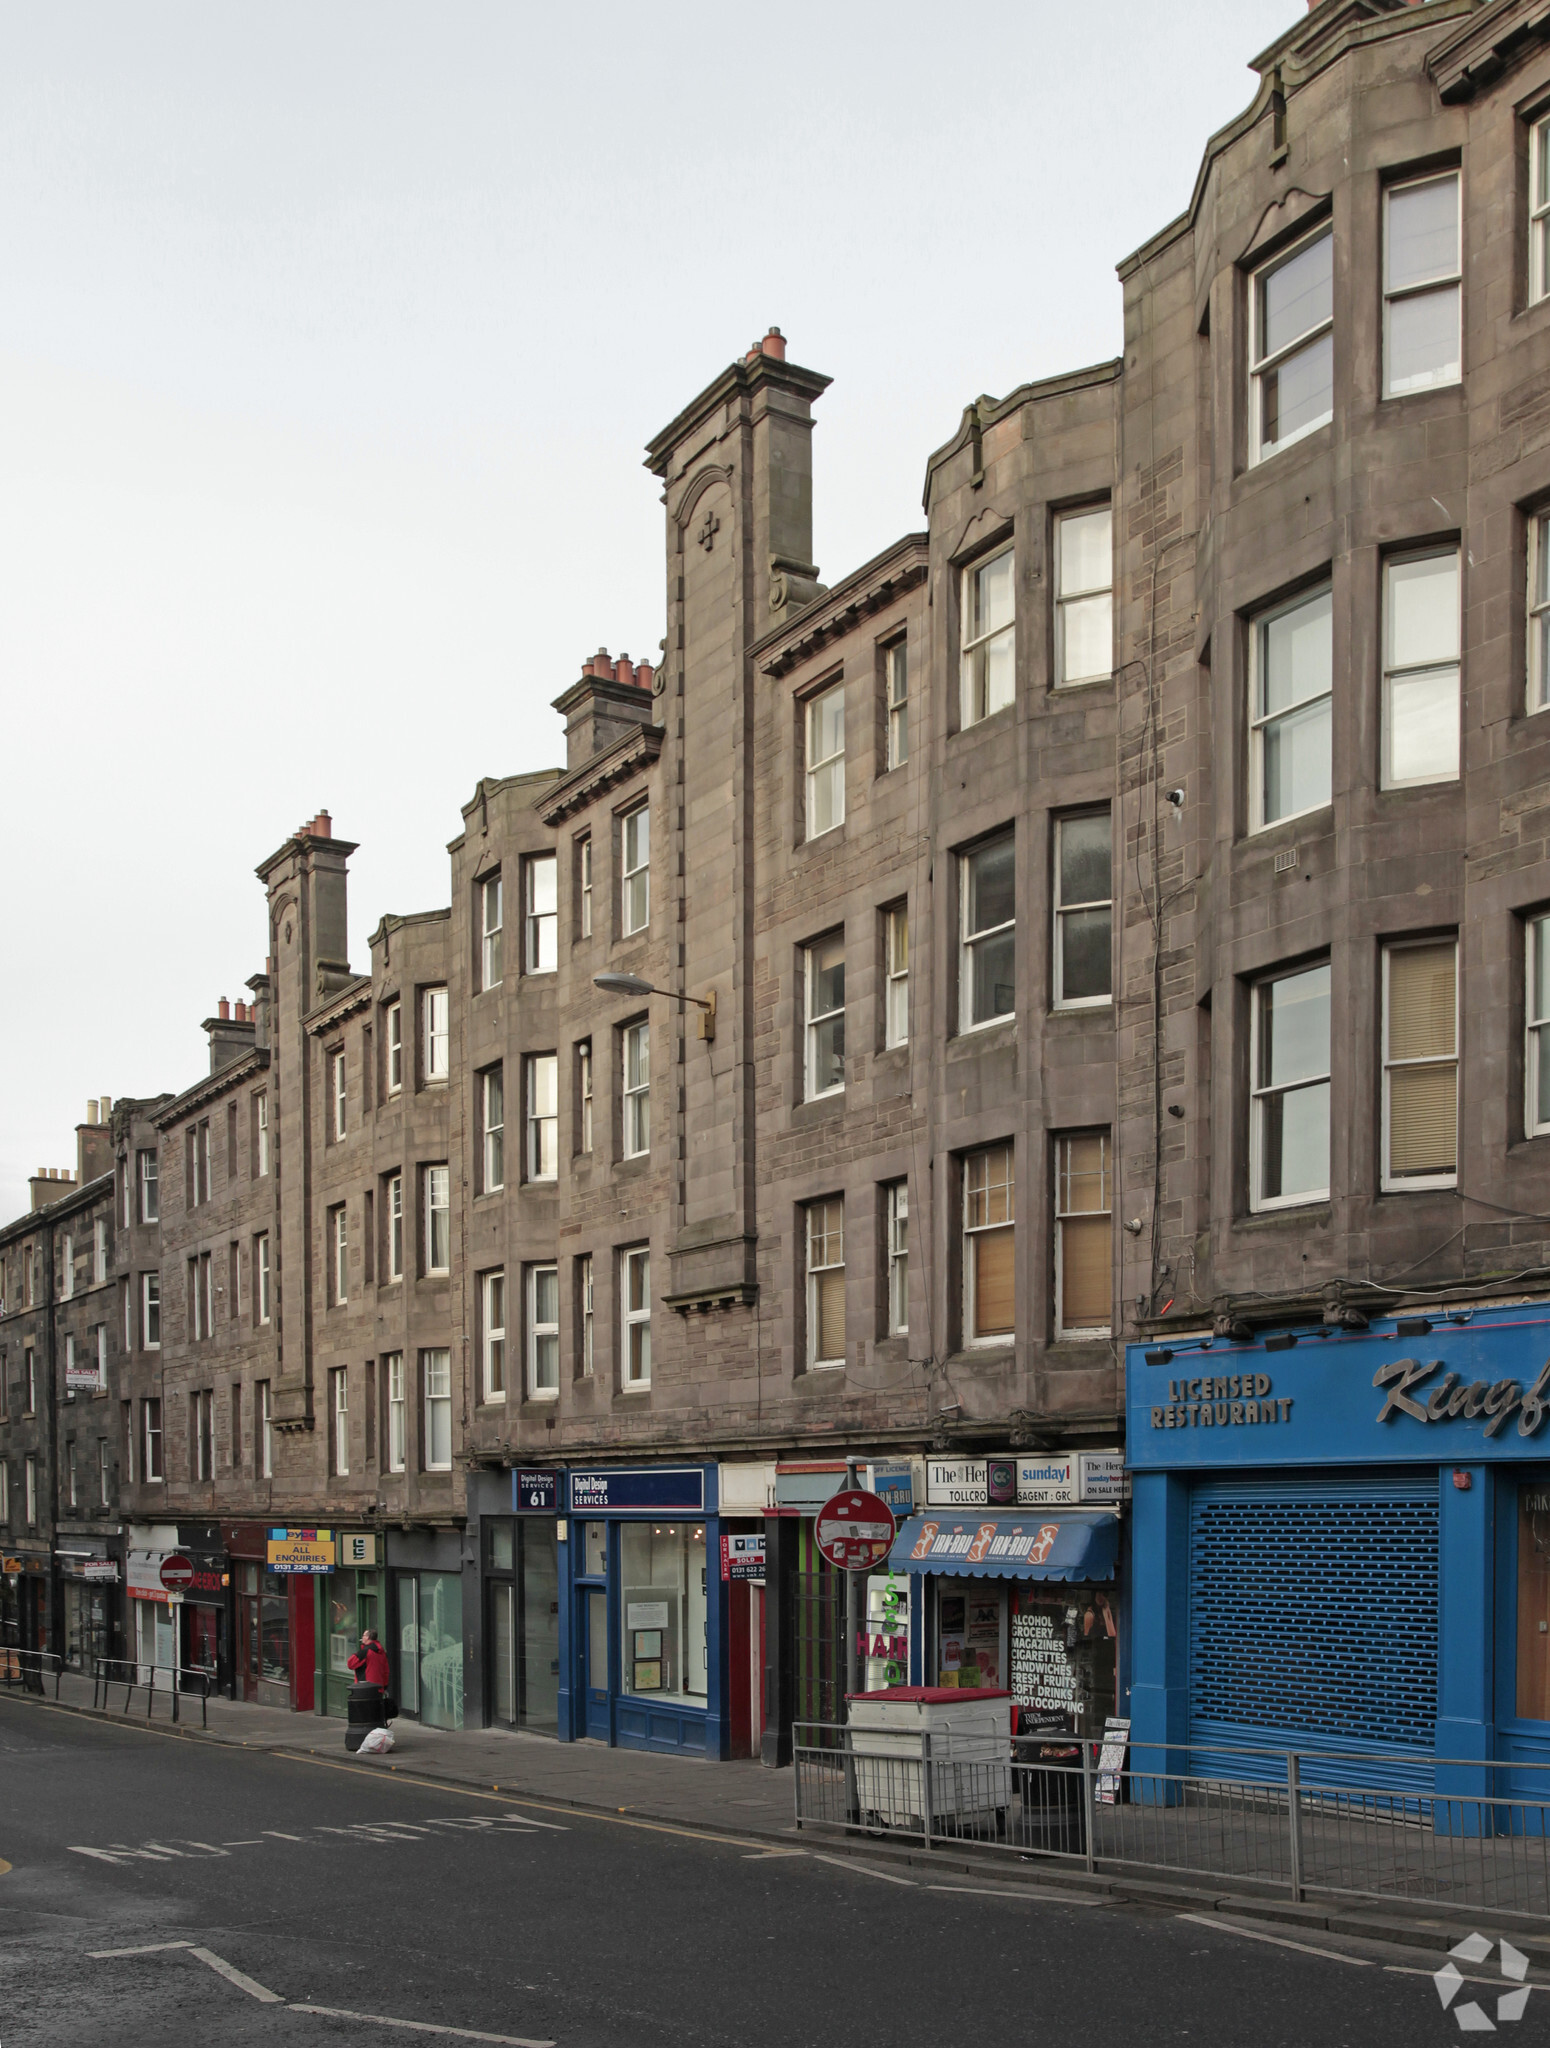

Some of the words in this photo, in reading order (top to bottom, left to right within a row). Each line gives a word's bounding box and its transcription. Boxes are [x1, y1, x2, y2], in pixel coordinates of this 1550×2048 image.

[1168, 1373, 1273, 1402] LICENSED
[1150, 1398, 1294, 1429] RESTAURANT
[1086, 1462, 1101, 1471] The
[521, 1474, 537, 1483] Digital
[537, 1474, 554, 1483] Design
[933, 1466, 957, 1483] The
[965, 1466, 987, 1483] Her
[574, 1476, 591, 1494] Digital
[591, 1476, 608, 1494] Design
[1098, 1486, 1112, 1494] SALE
[530, 1491, 545, 1506] 61
[574, 1495, 609, 1505] SERVICES
[949, 1491, 987, 1502] TOLLCRO
[1018, 1491, 1049, 1502] SAGENT
[292, 1546, 310, 1554] ALL
[275, 1554, 327, 1563] ENQUIRIES
[1011, 1614, 1053, 1627] ALCOHOL
[1011, 1626, 1054, 1639] GROCERY
[856, 1631, 908, 1660] HAIR
[1011, 1637, 1065, 1652] MAGAZINES
[1011, 1649, 1067, 1664] CIGARETTES
[1011, 1661, 1072, 1676] SANDWICHES
[1011, 1672, 1040, 1685] FRESH
[1043, 1675, 1077, 1689] FRUITS
[1011, 1683, 1034, 1695] SOFT
[1037, 1686, 1073, 1700] DRINKS
[1025, 1715, 1064, 1725] INDEPENDENT
